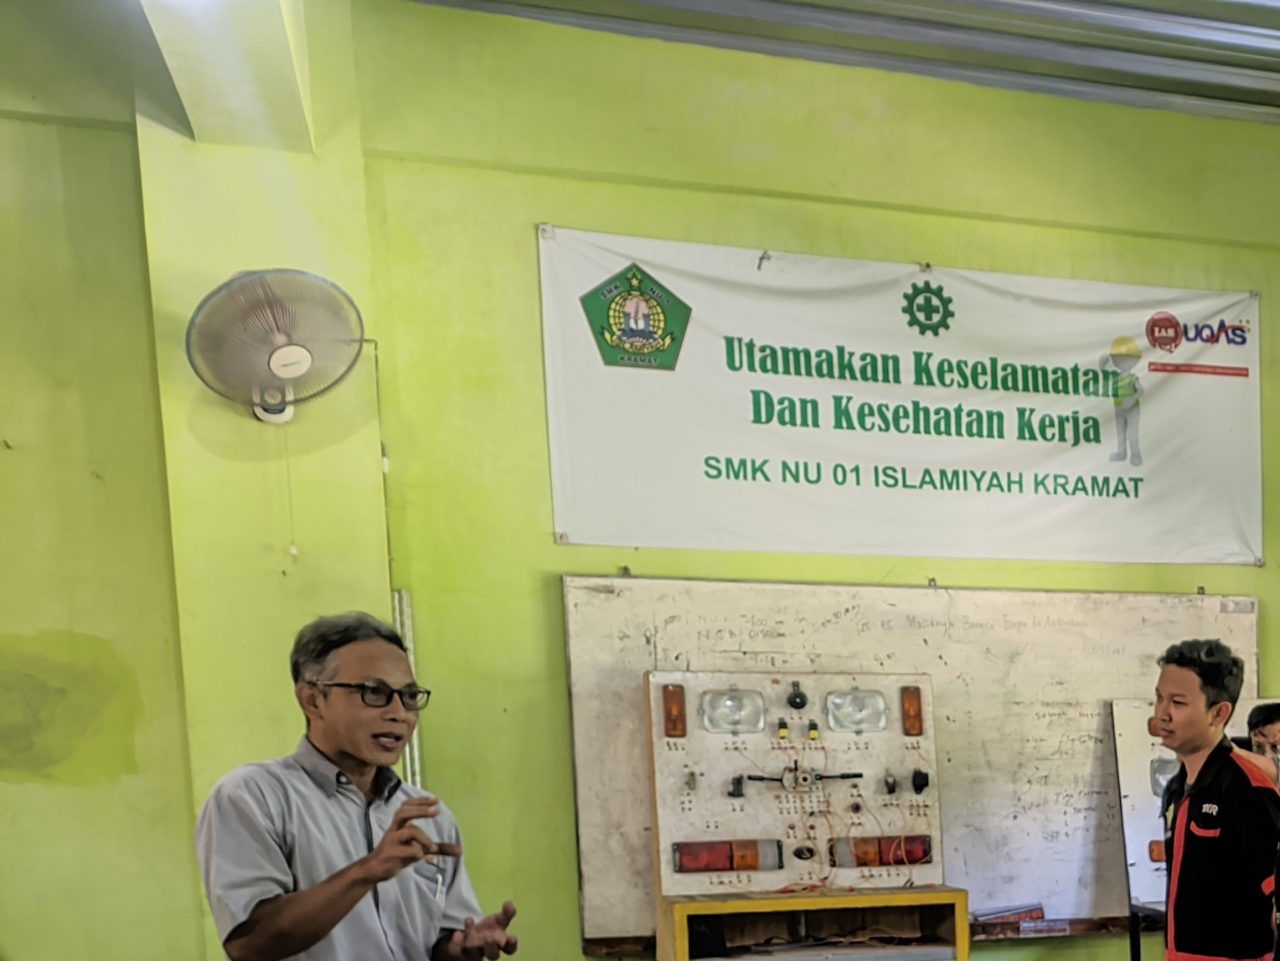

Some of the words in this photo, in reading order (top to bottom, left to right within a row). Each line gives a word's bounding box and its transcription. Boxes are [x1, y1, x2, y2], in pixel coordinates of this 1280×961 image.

[1183, 320, 1247, 346] UQAS
[725, 336, 901, 385] Utamakan
[914, 351, 1119, 399] Keselamatan
[752, 389, 821, 430] Dan
[832, 394, 1006, 441] Kesehatan
[1016, 406, 1102, 448] Kerja
[703, 455, 770, 482] SMK
[780, 460, 823, 485] NU
[831, 463, 862, 487] 01
[873, 465, 1025, 493] ISLAMIYAH
[1033, 474, 1143, 498] KRAMAT
